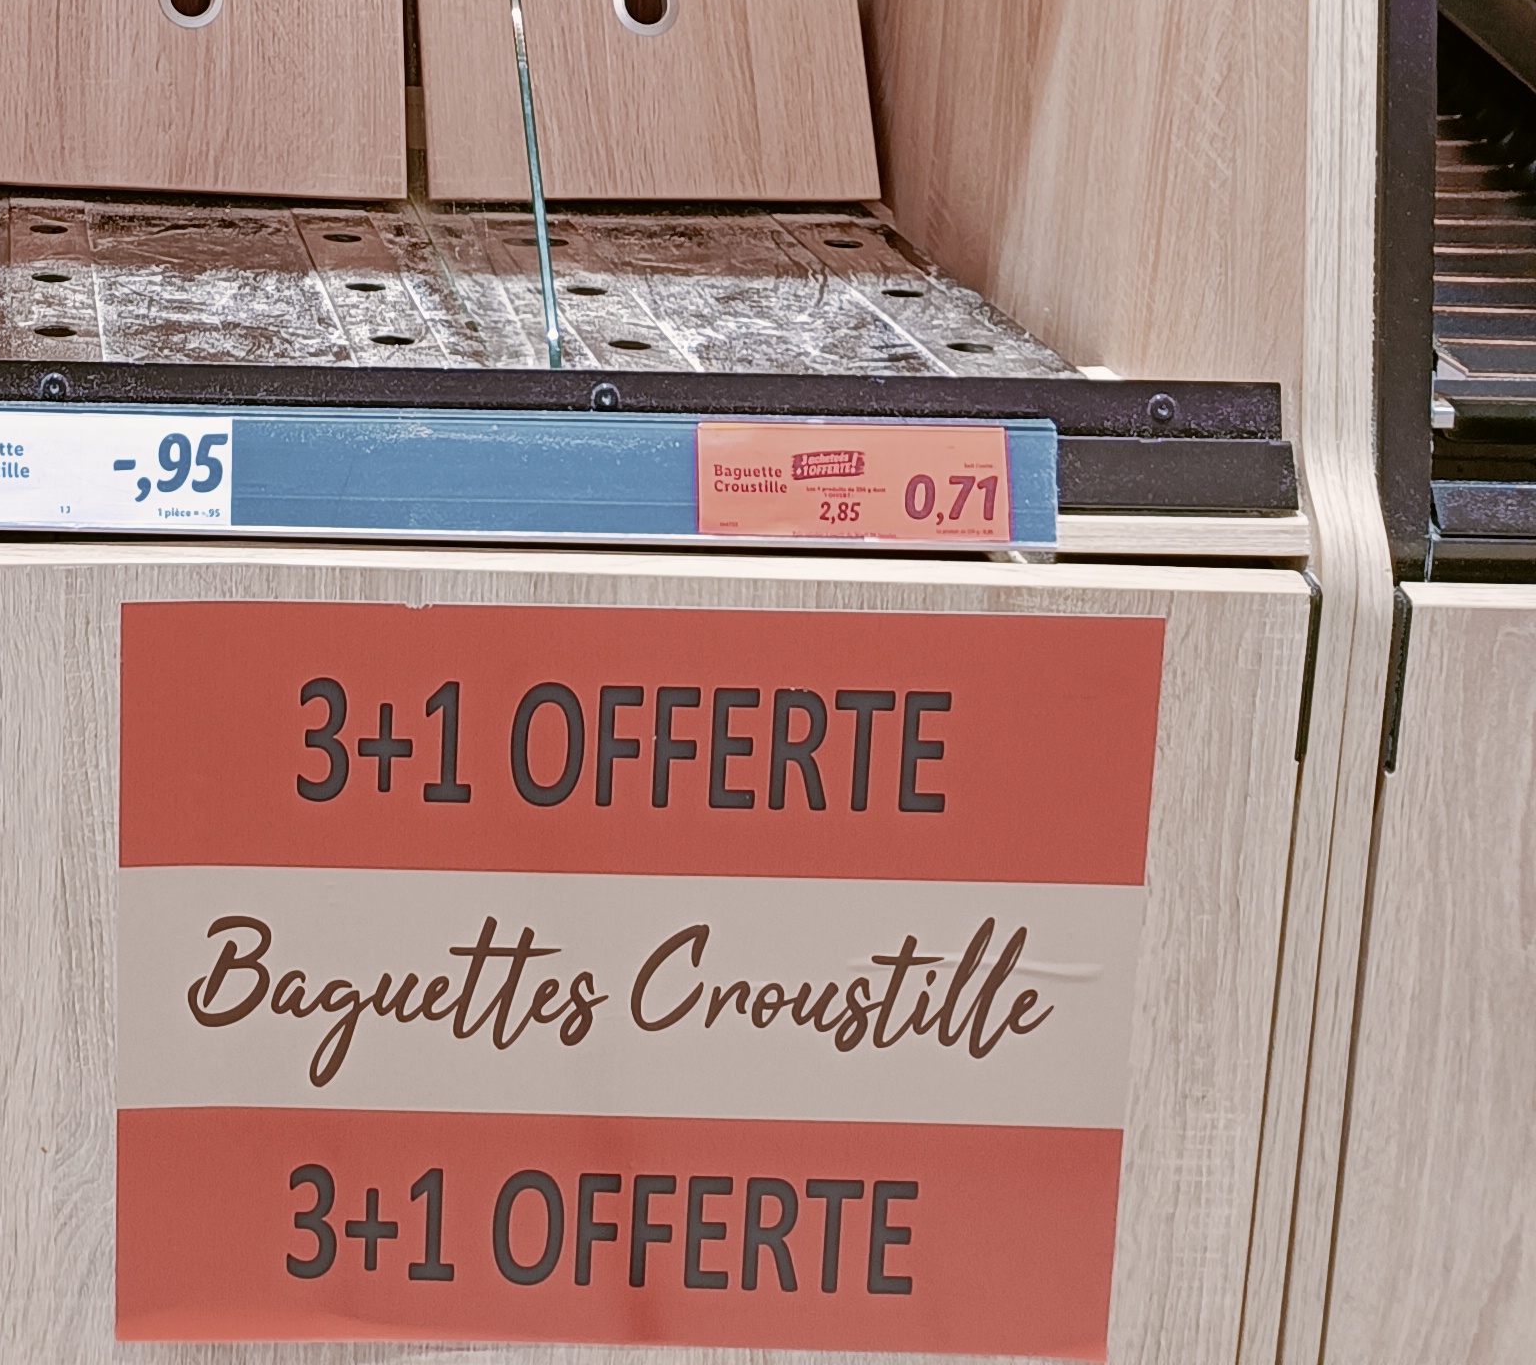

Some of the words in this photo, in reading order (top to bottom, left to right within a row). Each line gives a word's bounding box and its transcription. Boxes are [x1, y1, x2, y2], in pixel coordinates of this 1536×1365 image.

[113, 432, 229, 503] -,95
[713, 463, 782, 480] Baguette
[714, 479, 788, 494] Croustille
[164, 507, 191, 519] pièce
[819, 501, 861, 525] 2,85
[904, 474, 999, 526] 0,71
[295, 676, 472, 803] 3+1
[509, 682, 954, 814] OFFERTE
[187, 914, 609, 1088] Baguettes
[630, 916, 1055, 1060] Croustille
[285, 1163, 456, 1282] 3+1
[491, 1169, 920, 1295] OFFERTE
